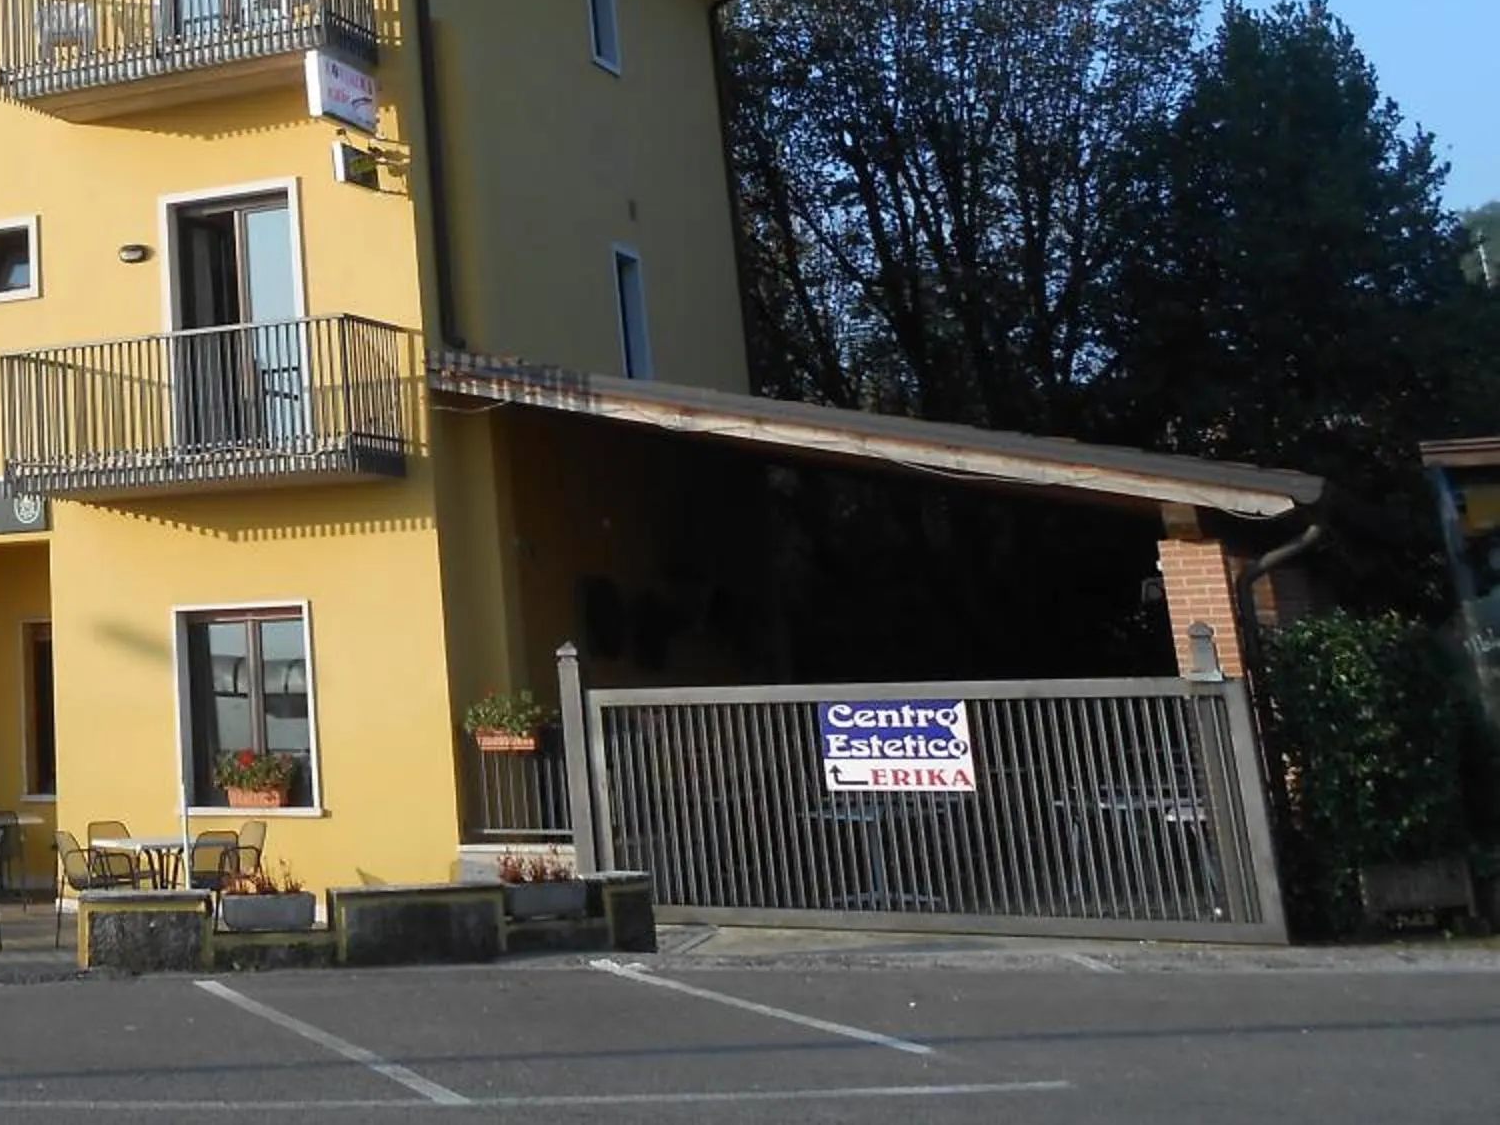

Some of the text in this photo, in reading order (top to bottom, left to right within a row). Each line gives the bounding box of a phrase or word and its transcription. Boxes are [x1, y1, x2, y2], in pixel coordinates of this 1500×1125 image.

[827, 704, 958, 728] Centro
[825, 734, 968, 758] Estetico
[870, 768, 974, 788] ERIKA
